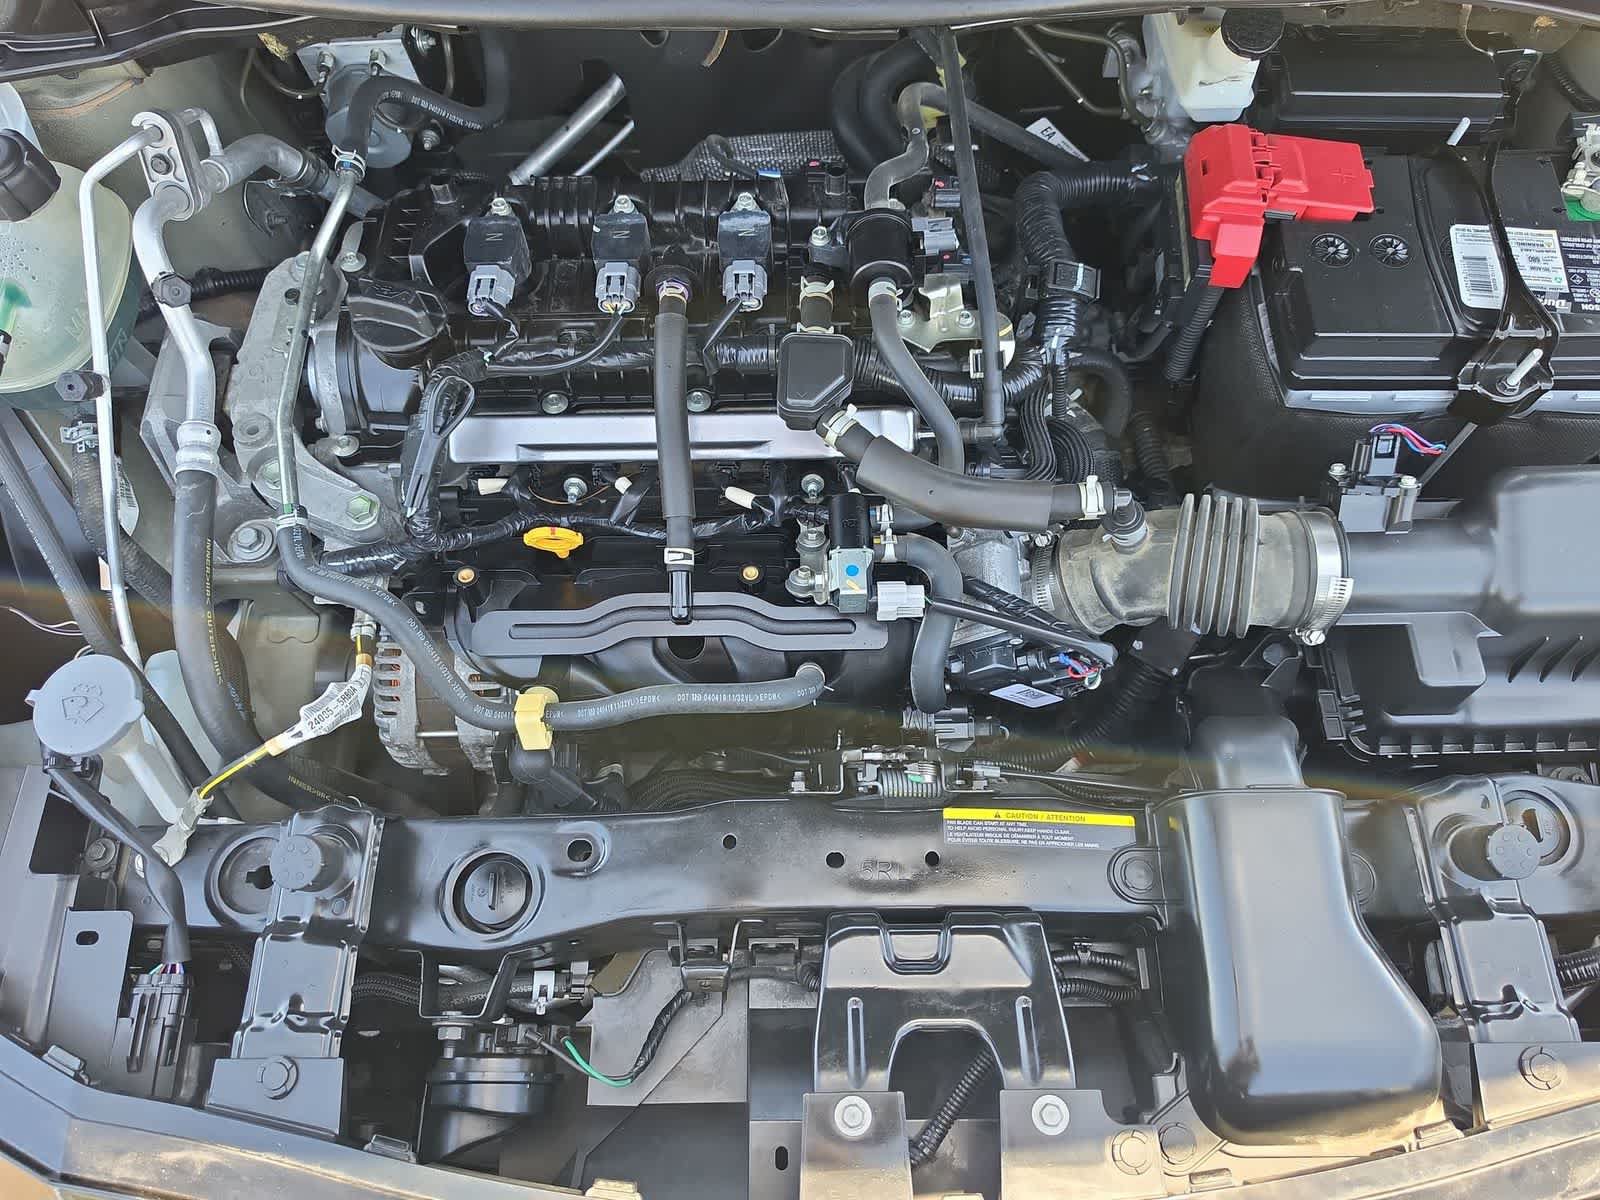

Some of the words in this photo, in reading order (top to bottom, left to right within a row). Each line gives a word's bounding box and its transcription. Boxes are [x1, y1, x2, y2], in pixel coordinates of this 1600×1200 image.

[1040, 126, 1057, 140] EA
[1006, 812, 1039, 820] CAUTION
[1046, 814, 1086, 822] ATTENTION
